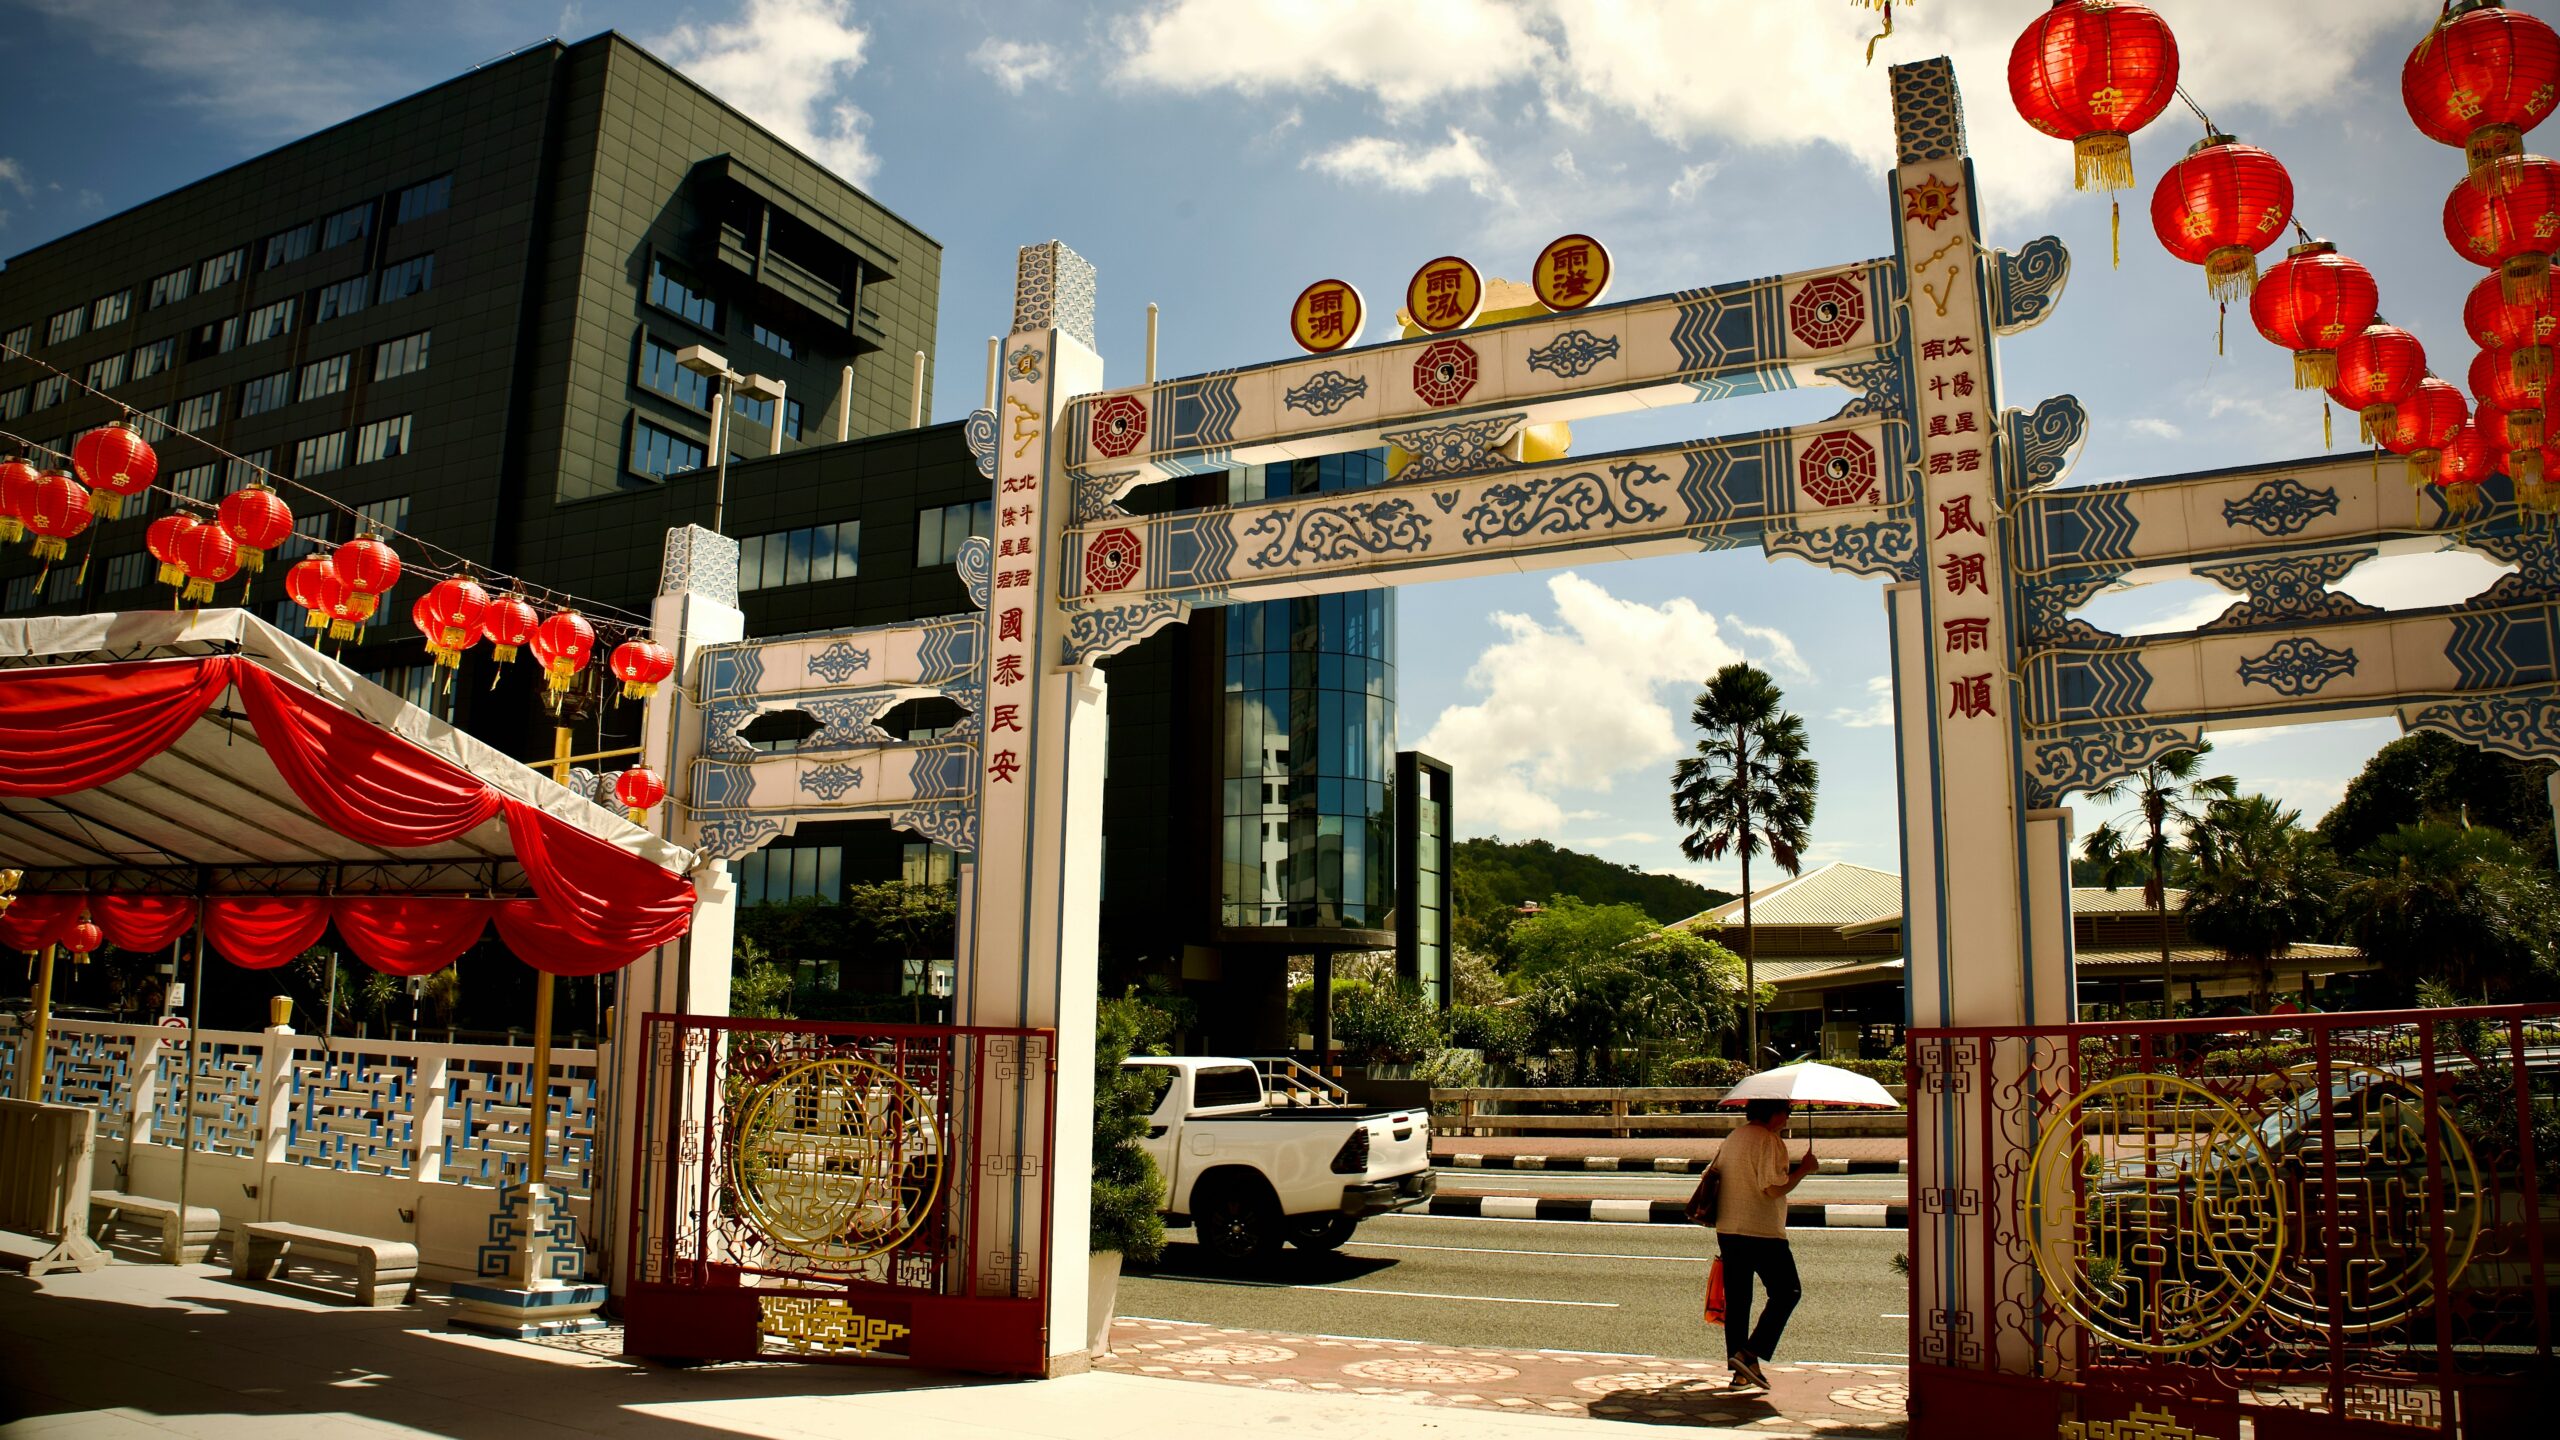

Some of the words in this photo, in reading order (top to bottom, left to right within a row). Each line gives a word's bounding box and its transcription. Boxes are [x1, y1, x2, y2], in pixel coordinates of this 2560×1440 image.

[1921, 338, 1954, 475] 南斗星君
[1947, 335, 1981, 472] 太陽星君
[997, 477, 1019, 589] 太陰星君
[1014, 474, 1037, 588] 北斗星君
[1935, 494, 1997, 720] 風調雨順
[987, 607, 1025, 783] 國泰民安
